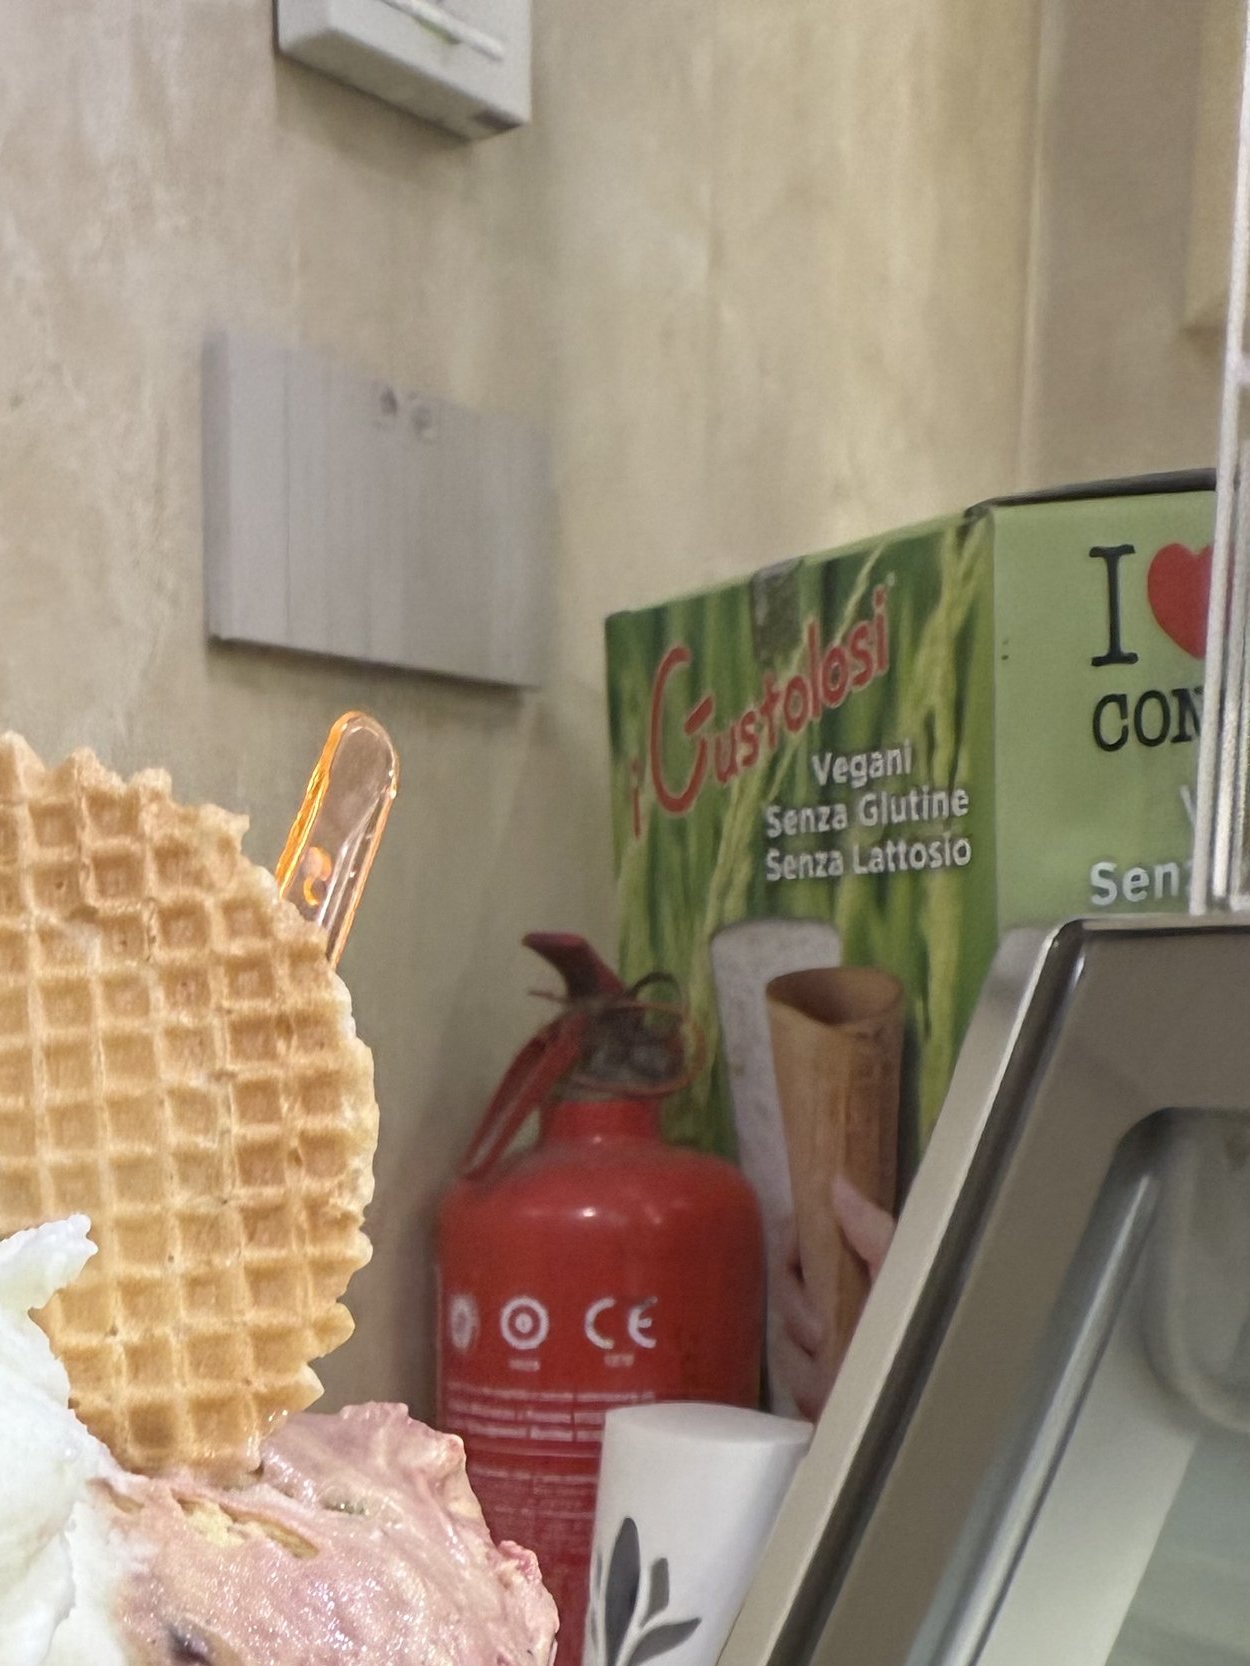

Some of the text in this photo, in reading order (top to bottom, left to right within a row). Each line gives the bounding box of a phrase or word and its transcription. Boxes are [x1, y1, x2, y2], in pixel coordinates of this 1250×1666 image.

[1087, 544, 1139, 667] I
[650, 585, 890, 814] Gustolosi
[812, 739, 912, 788] Vegani
[765, 785, 970, 838] Senza Glutine
[765, 831, 972, 881] Senza Lattosio
[1089, 860, 1193, 906] Sen
